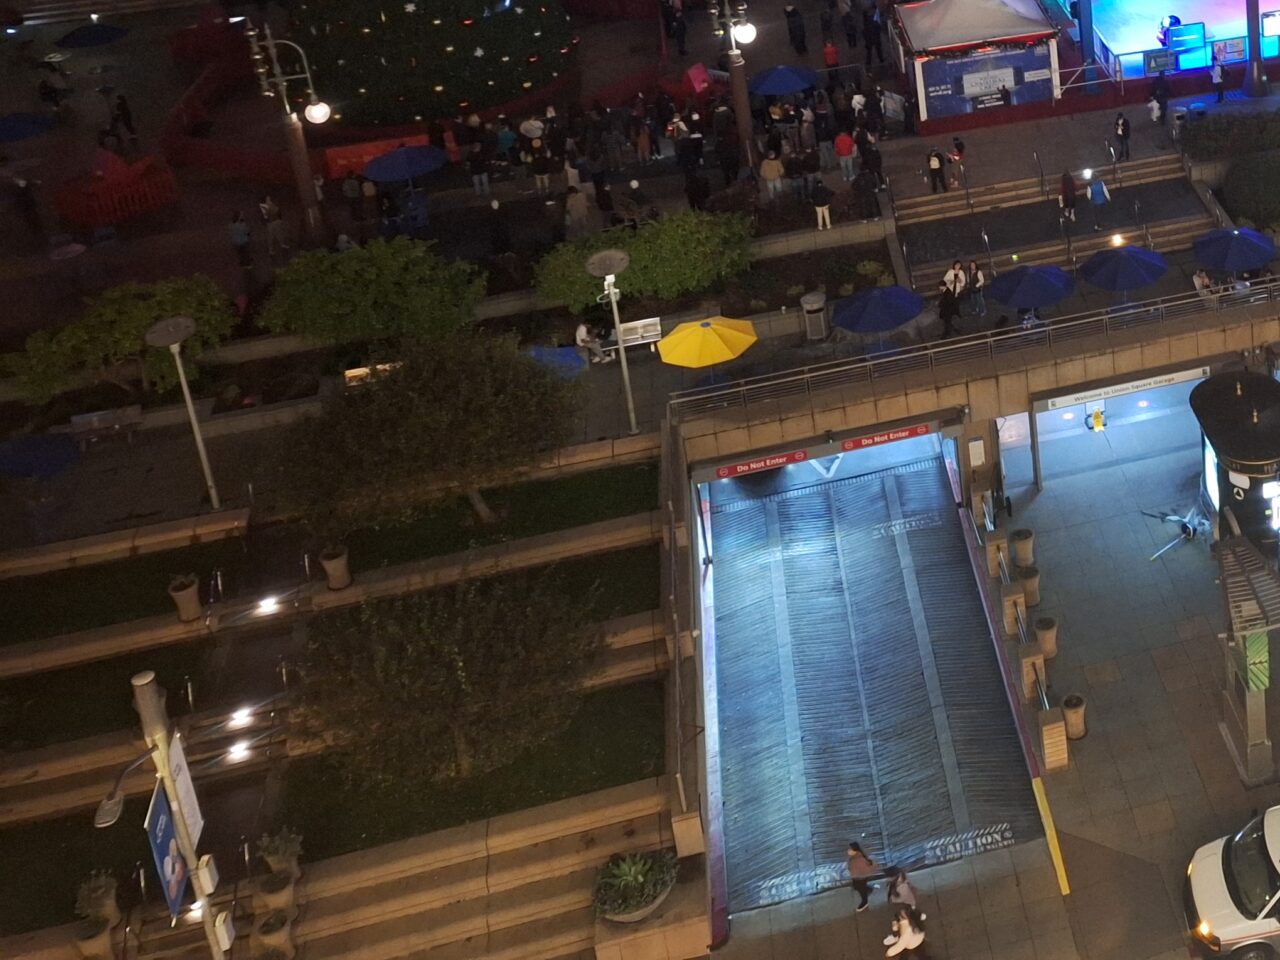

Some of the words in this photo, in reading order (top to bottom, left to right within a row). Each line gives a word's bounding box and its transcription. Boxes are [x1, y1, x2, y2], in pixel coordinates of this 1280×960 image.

[1074, 391, 1103, 402] Welcome
[1111, 385, 1131, 395] Union
[1131, 380, 1153, 390] Square
[1153, 376, 1176, 386] Garage
[861, 437, 874, 446] Do
[874, 433, 889, 443] Not
[889, 429, 910, 440] Enter
[736, 464, 749, 473] Do
[750, 460, 765, 470] Not
[766, 456, 788, 467] Enter
[935, 832, 1002, 857] CAUTION
